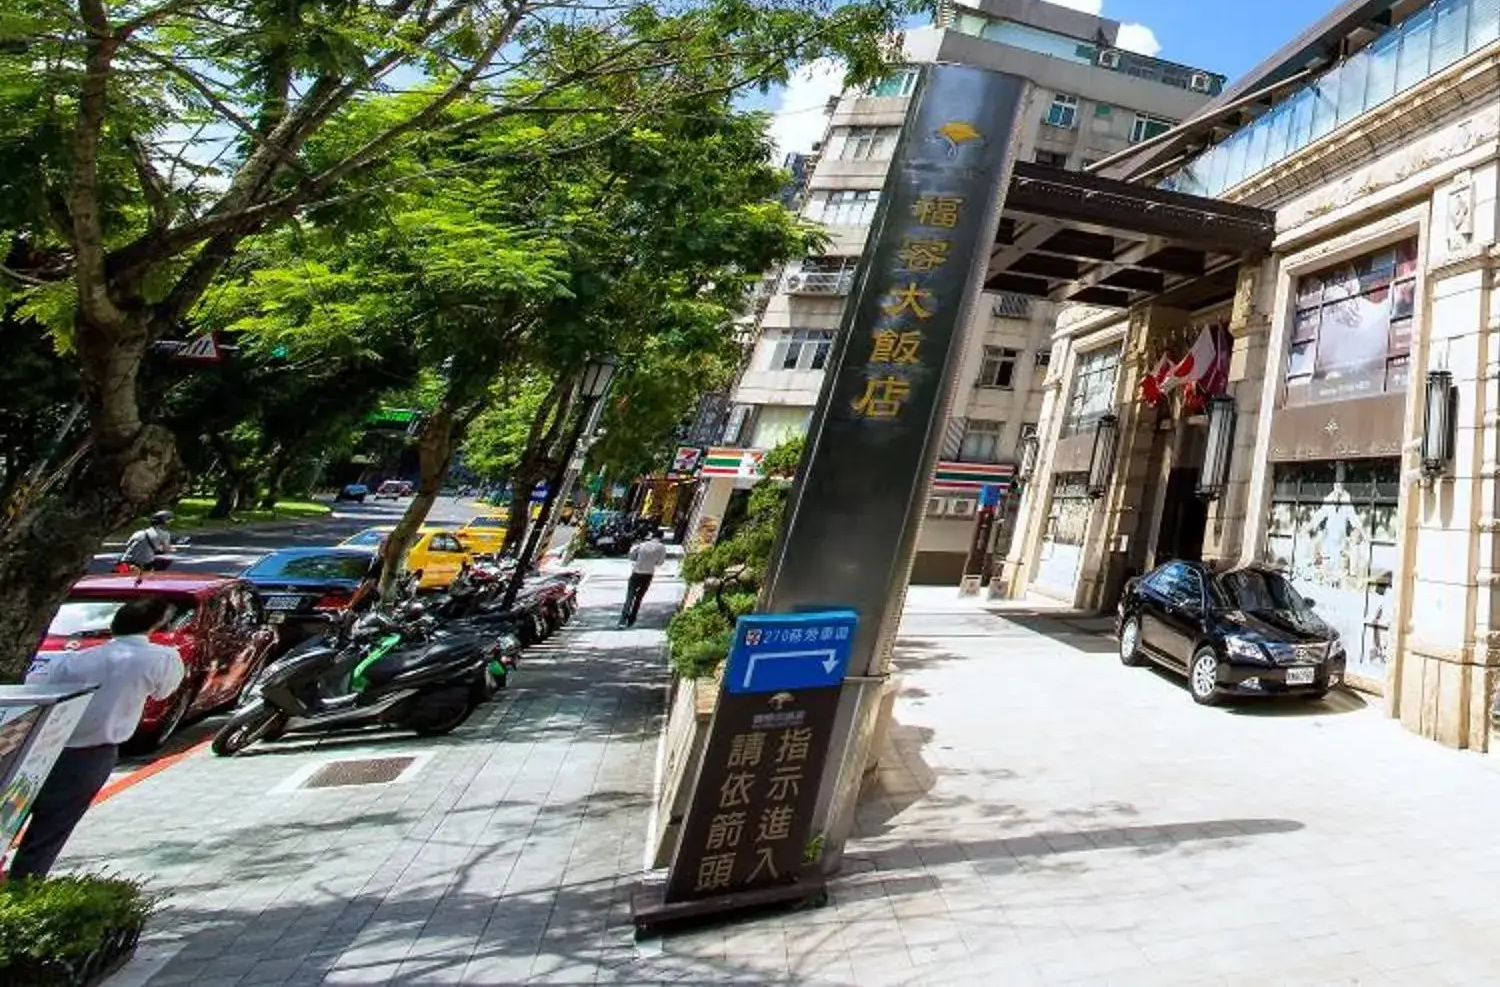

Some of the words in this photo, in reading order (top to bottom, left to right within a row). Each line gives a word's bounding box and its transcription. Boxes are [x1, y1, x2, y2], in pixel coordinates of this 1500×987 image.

[852, 195, 964, 418] 福容大飯店
[694, 731, 767, 892] 請依箭頭
[744, 725, 814, 884] 指示進入
